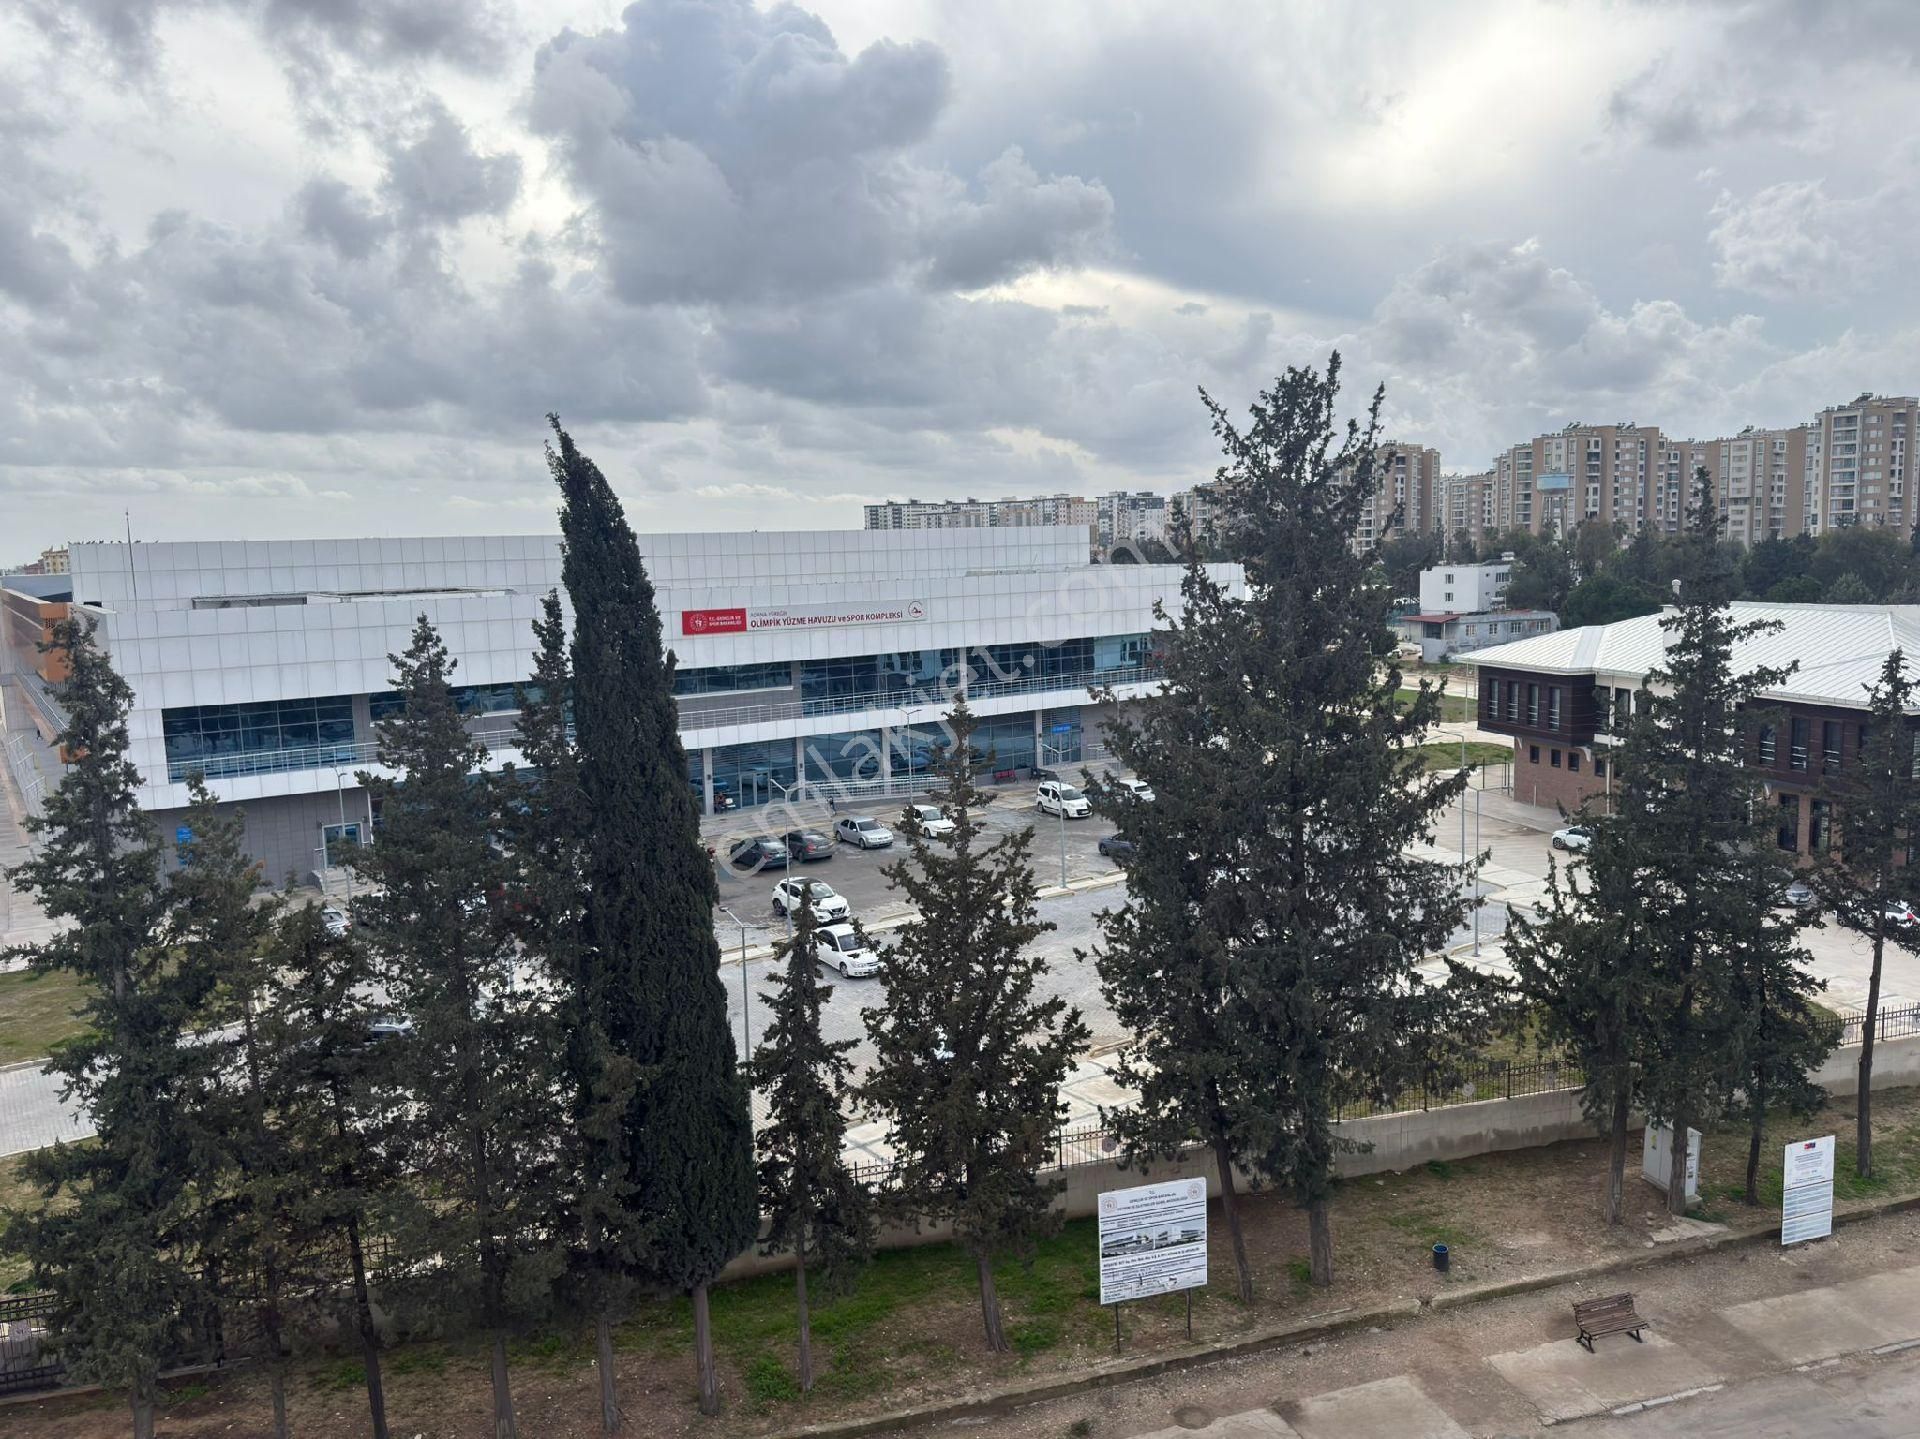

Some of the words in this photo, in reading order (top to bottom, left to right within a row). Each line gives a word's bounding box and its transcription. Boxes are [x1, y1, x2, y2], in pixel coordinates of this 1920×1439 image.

[750, 617, 781, 628] OLİMPİK
[782, 616, 807, 626] YÜZME
[808, 615, 836, 625] HAVUZU
[865, 610, 903, 620] KOMPLEKSİ
